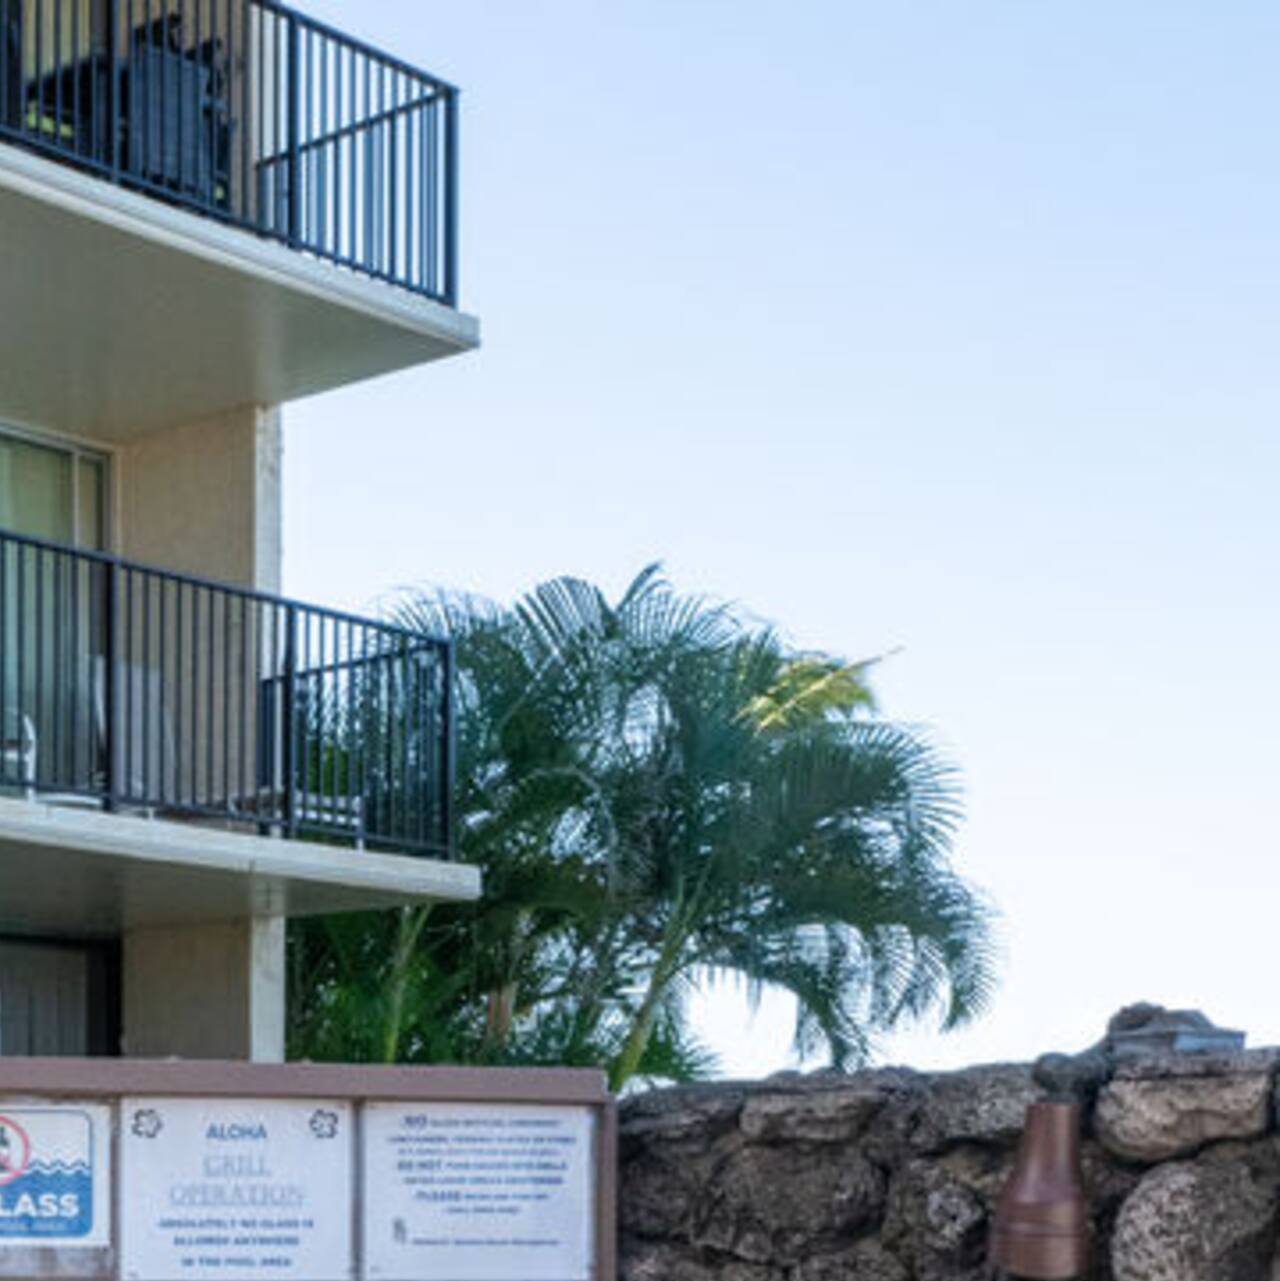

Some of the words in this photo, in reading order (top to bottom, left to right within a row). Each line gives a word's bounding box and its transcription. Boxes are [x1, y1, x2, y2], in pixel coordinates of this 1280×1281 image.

[205, 1123, 268, 1140] ALOHA
[203, 1154, 272, 1177] GRILL
[170, 1184, 306, 1206] OPERATION
